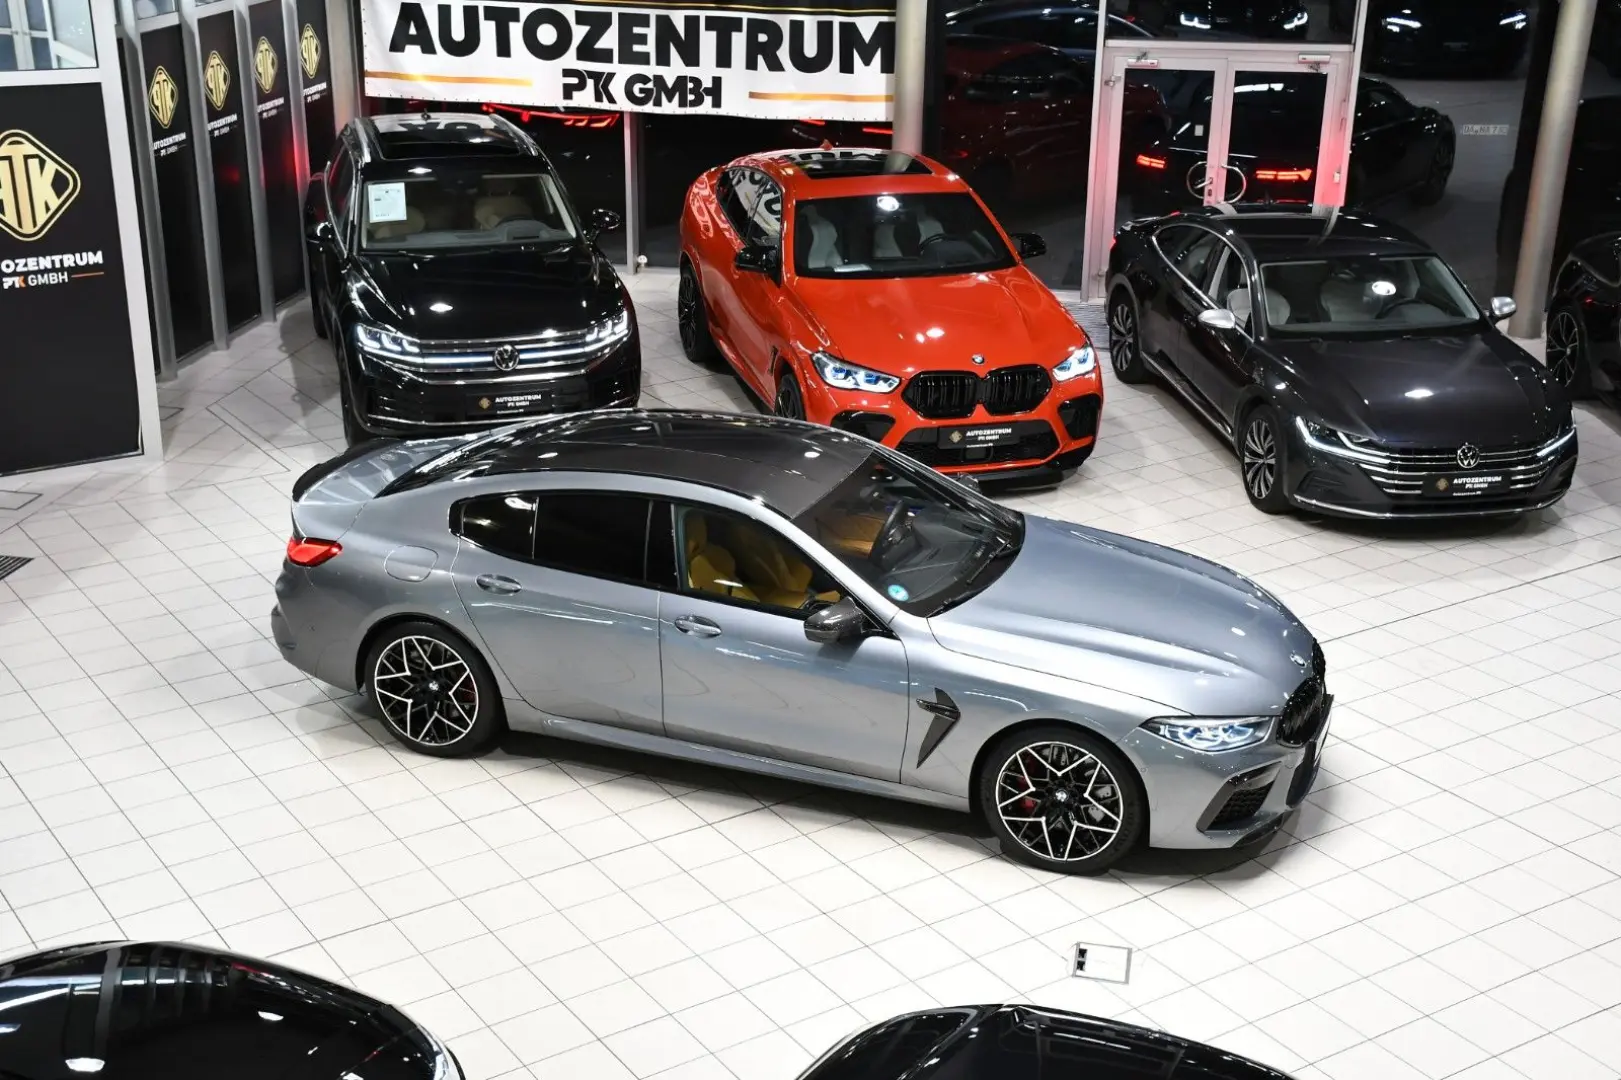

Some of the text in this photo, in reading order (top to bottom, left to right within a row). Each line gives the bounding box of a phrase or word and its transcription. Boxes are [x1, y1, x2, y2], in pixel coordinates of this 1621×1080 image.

[389, 2, 896, 74] AUTOZENTRUM
[562, 68, 722, 108] PTK GMBH
[28, 271, 69, 287] GMBH
[495, 394, 542, 403] AUTOZENTRUM
[966, 428, 1012, 436] AUTOZENTRUM
[1453, 476, 1502, 484] AUTOZENTRUM
